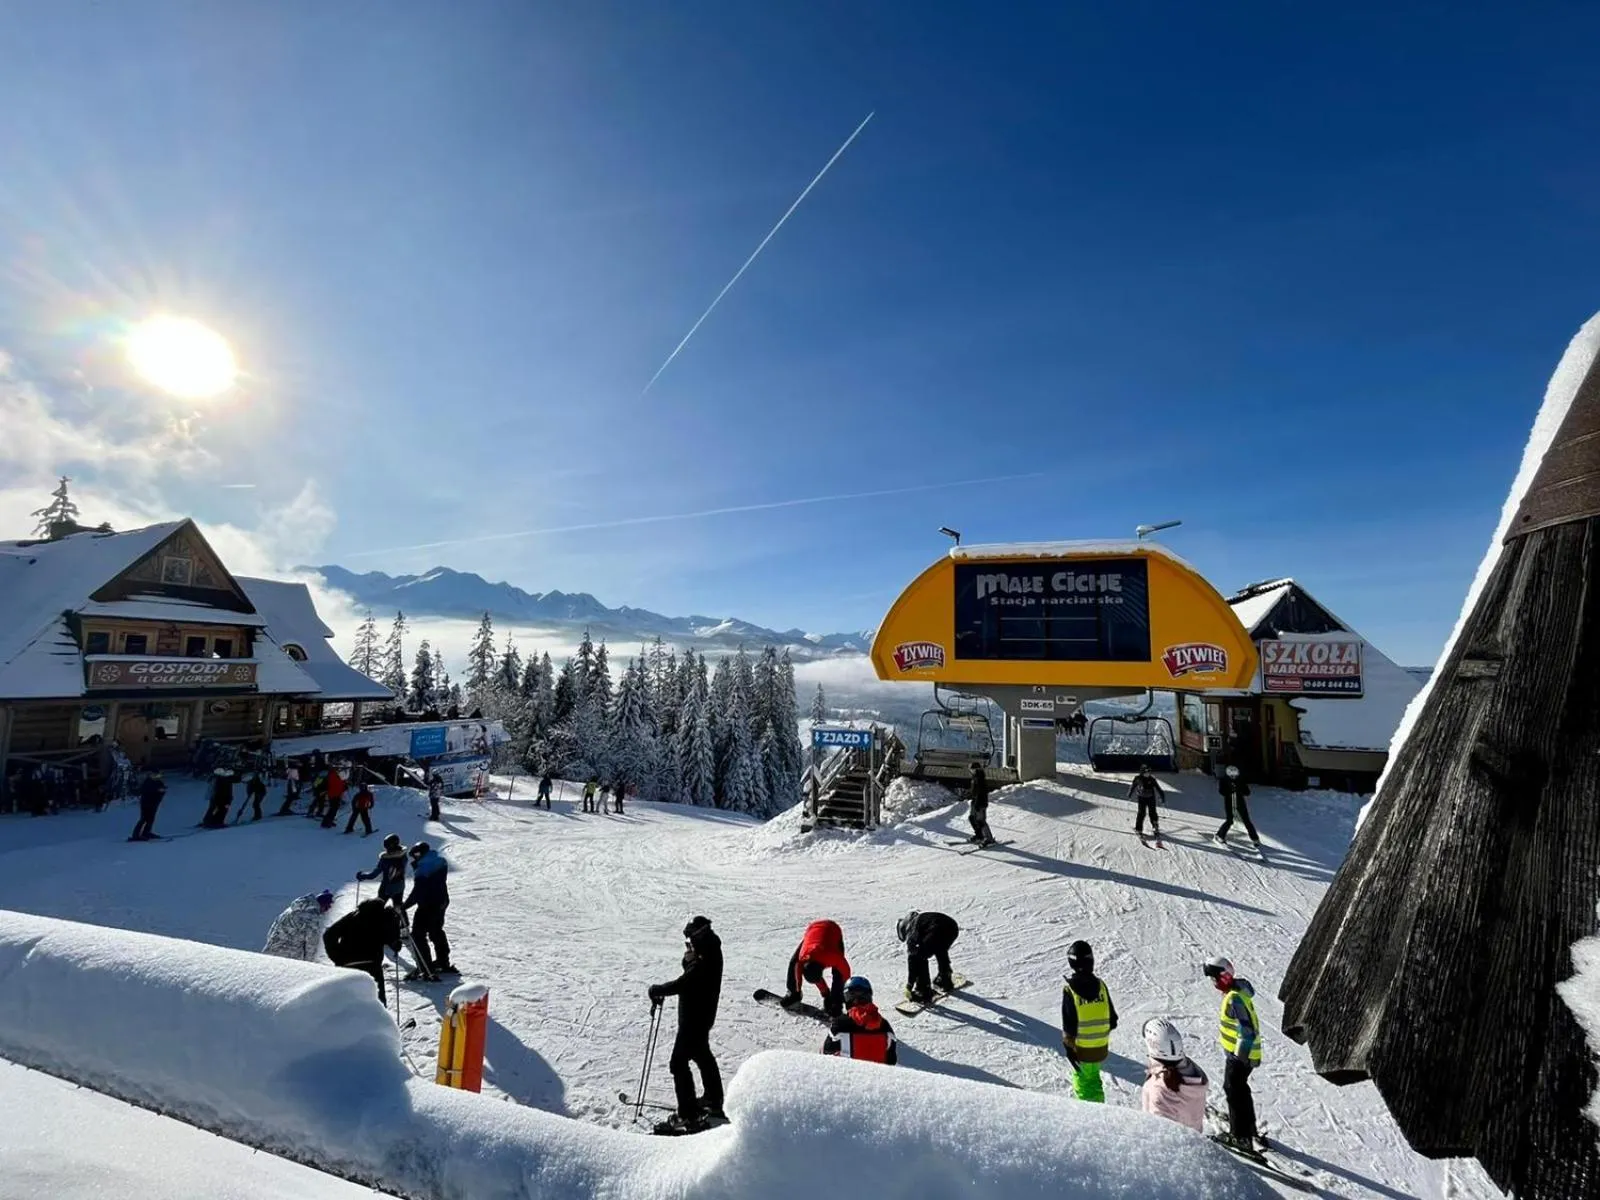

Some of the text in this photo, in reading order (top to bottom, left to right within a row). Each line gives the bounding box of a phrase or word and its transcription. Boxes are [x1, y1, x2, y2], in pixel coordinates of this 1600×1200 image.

[990, 596, 1036, 607] Stacja
[1265, 643, 1358, 664] SZKOŁA
[129, 662, 229, 674] GOSPODA
[1269, 664, 1355, 674] NARCIARSKA
[822, 732, 861, 744] ZJAZD
